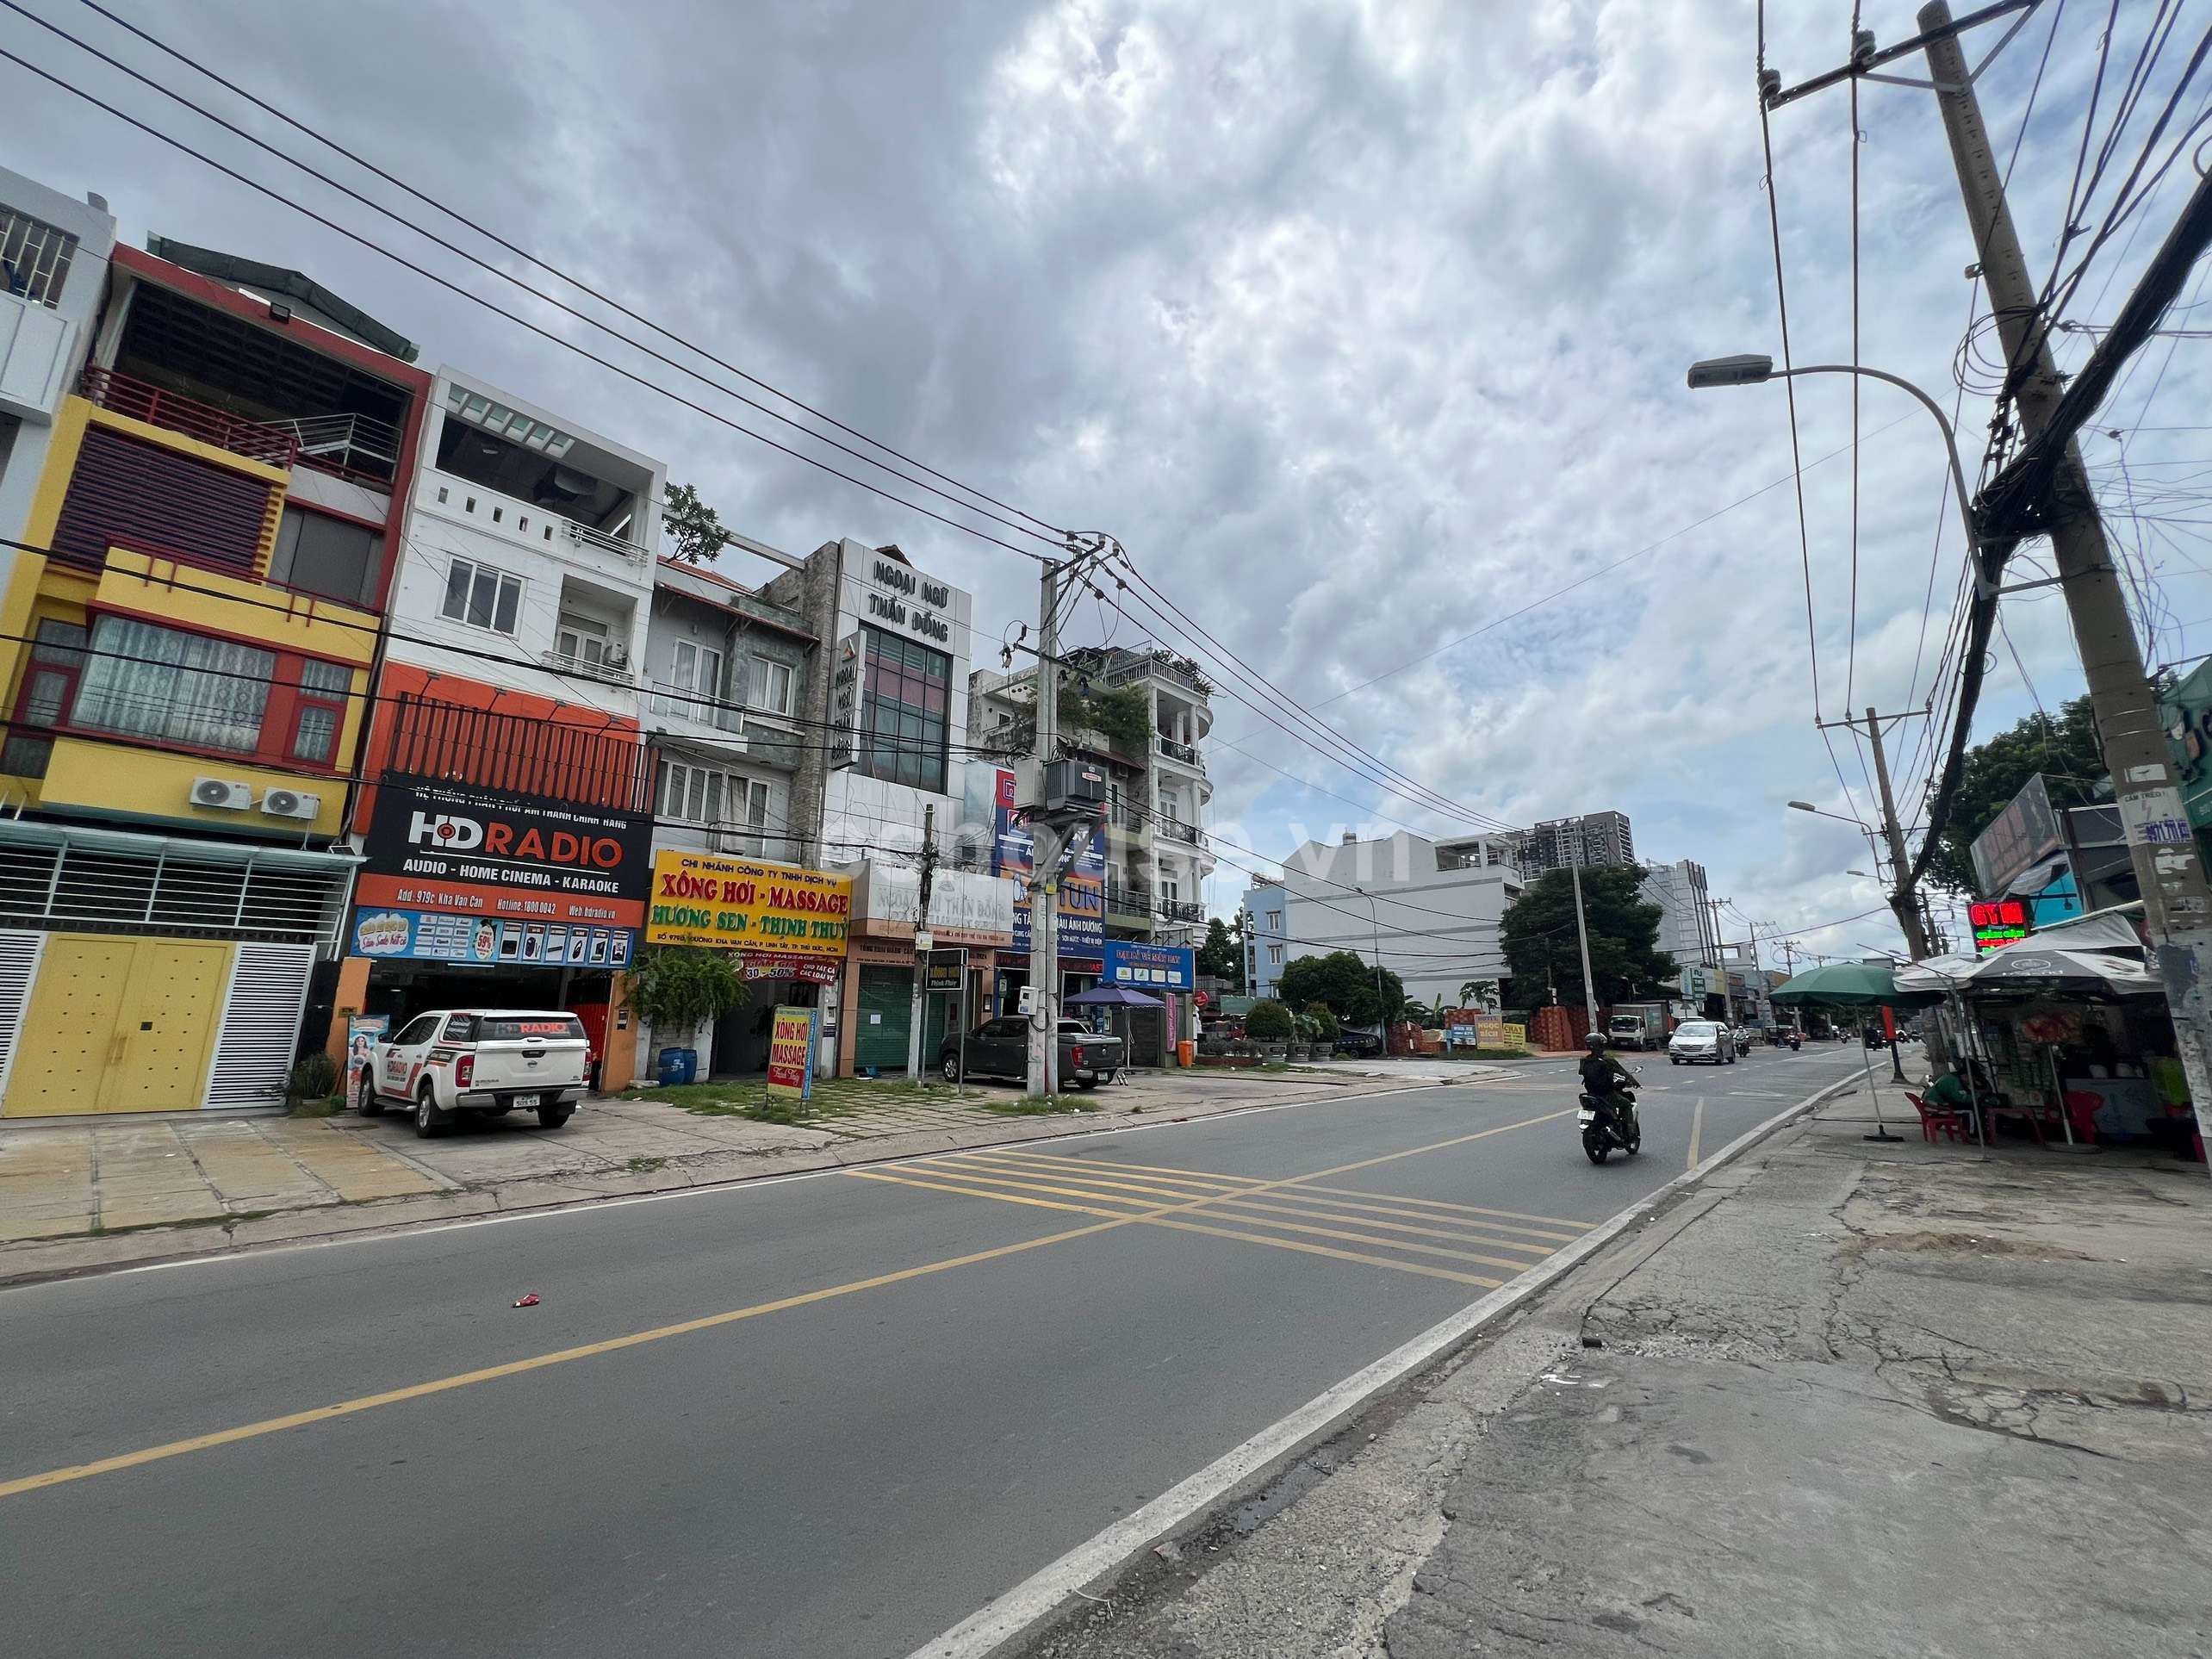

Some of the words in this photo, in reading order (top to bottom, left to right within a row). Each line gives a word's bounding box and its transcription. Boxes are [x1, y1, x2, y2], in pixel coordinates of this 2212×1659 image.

[873, 560, 916, 595] NGOẠI
[921, 581, 949, 608] NGỮ
[403, 858, 447, 874] AUDIO
[459, 865, 498, 880] HOME
[501, 868, 551, 886] CINEMA
[562, 876, 619, 893] KARAOKE
[681, 859, 699, 868] CHI
[703, 860, 734, 873] NHÁNH
[737, 864, 764, 877] CÔNG
[768, 869, 778, 879] TY
[781, 872, 802, 882] TNHH
[805, 874, 823, 885] DỊCH
[438, 892, 452, 905] Kha
[660, 869, 718, 900] XÔNG
[721, 879, 756, 904] HƠI
[767, 886, 848, 914] MASSAGE
[649, 904, 711, 929] HƯƠNG
[717, 911, 749, 931] SEN
[760, 916, 807, 940] THỊNH
[774, 1017, 795, 1041] XÔNG
[796, 1020, 808, 1041] HƠI
[772, 1043, 806, 1066] MASSAGE
